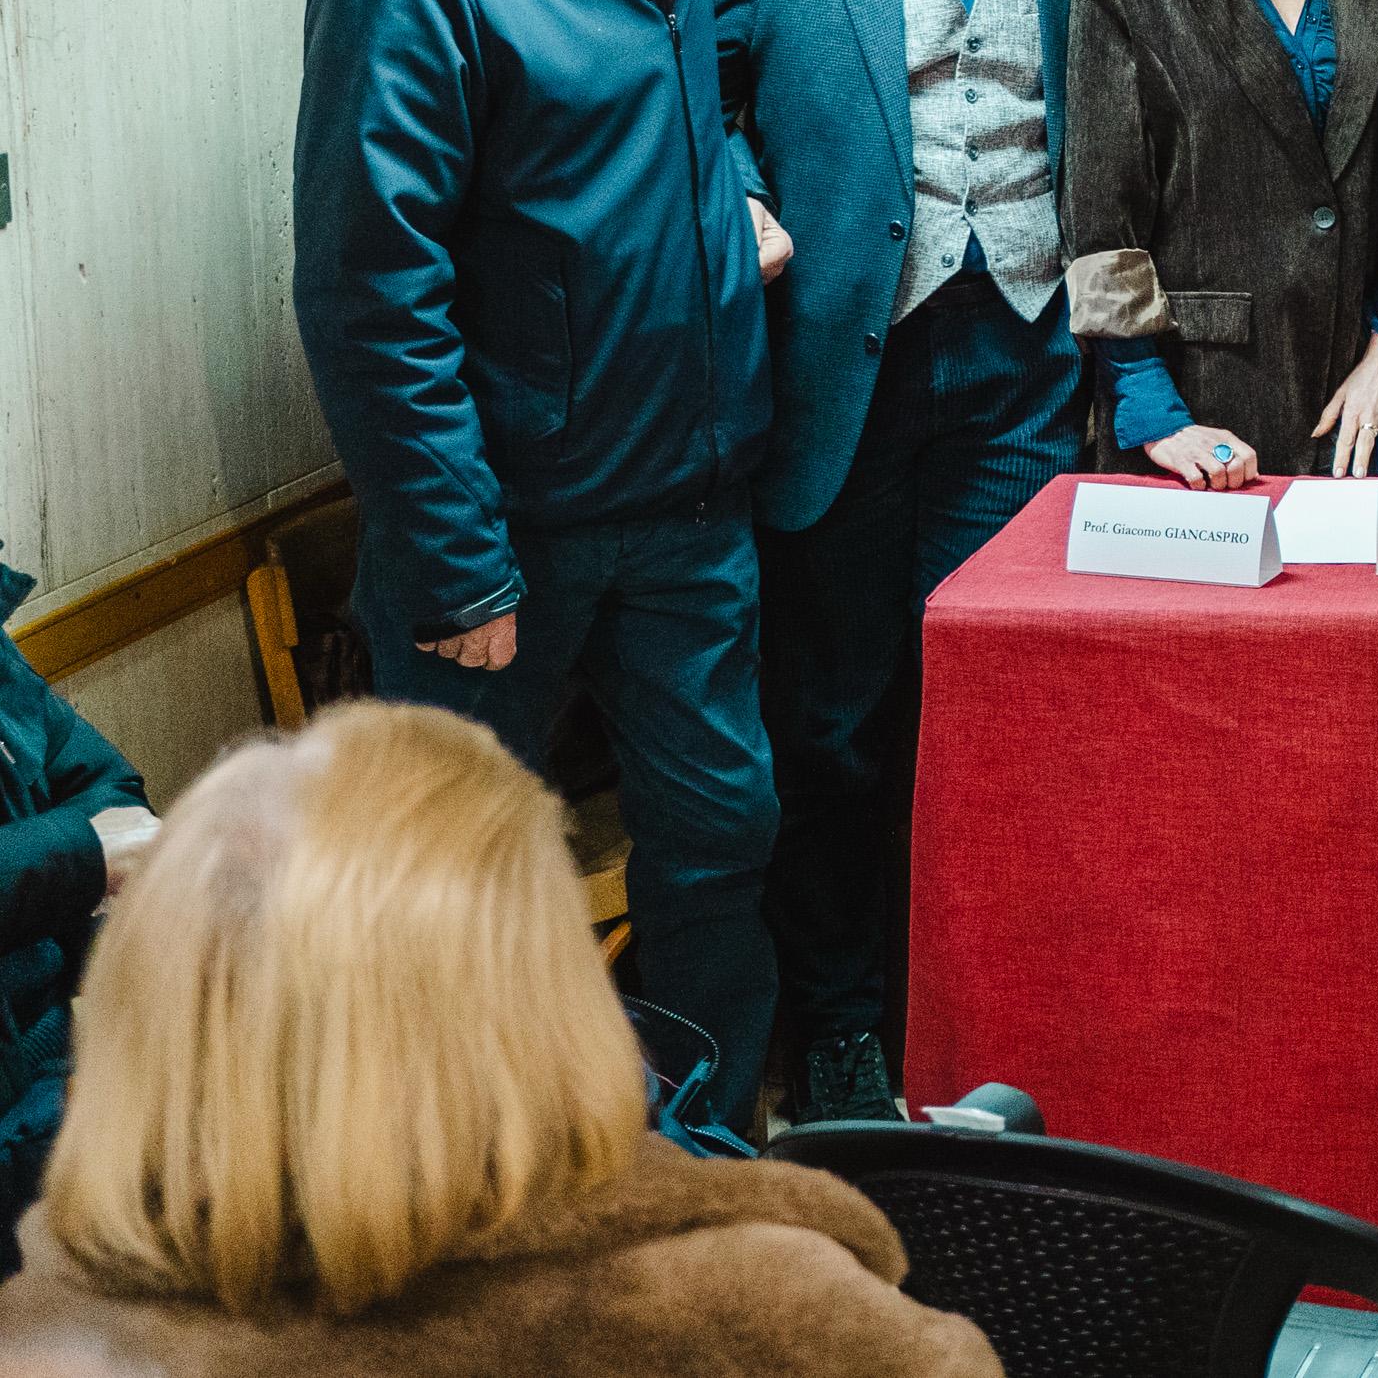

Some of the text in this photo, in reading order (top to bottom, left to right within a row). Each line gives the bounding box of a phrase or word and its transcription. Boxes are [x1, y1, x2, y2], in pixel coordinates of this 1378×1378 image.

[1083, 521, 1249, 545] Prof. Giacomo GIANCASPRO
